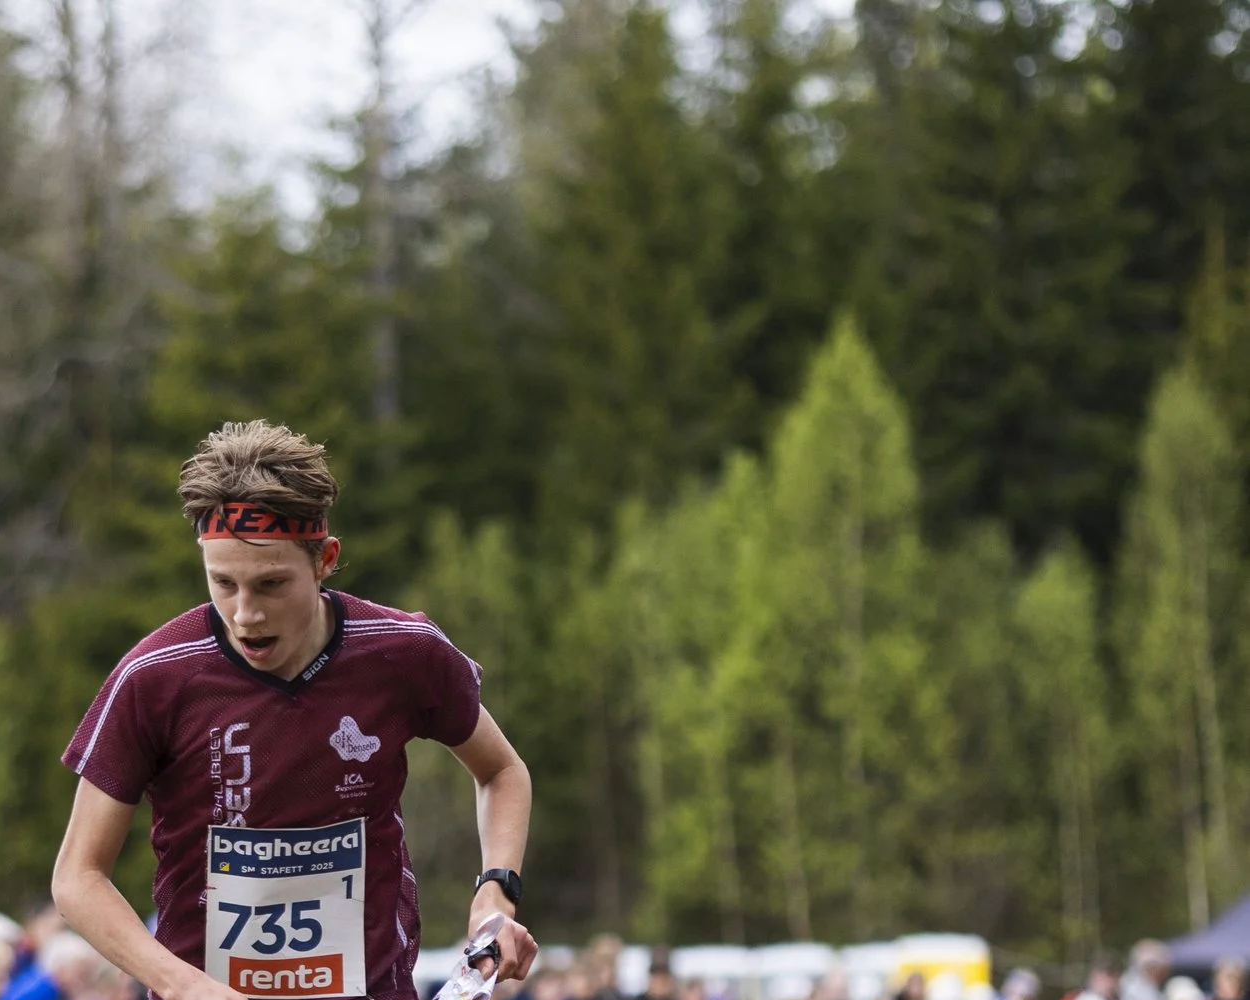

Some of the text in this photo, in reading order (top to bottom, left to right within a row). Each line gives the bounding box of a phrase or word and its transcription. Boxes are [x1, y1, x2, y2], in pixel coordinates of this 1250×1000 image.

[344, 773, 363, 785] ICA
[214, 832, 359, 861] bagheera
[261, 866, 303, 875] STAFETT
[311, 862, 334, 871] 2025
[342, 875, 353, 899] 1
[218, 900, 322, 954] 735
[239, 965, 333, 990] renta
